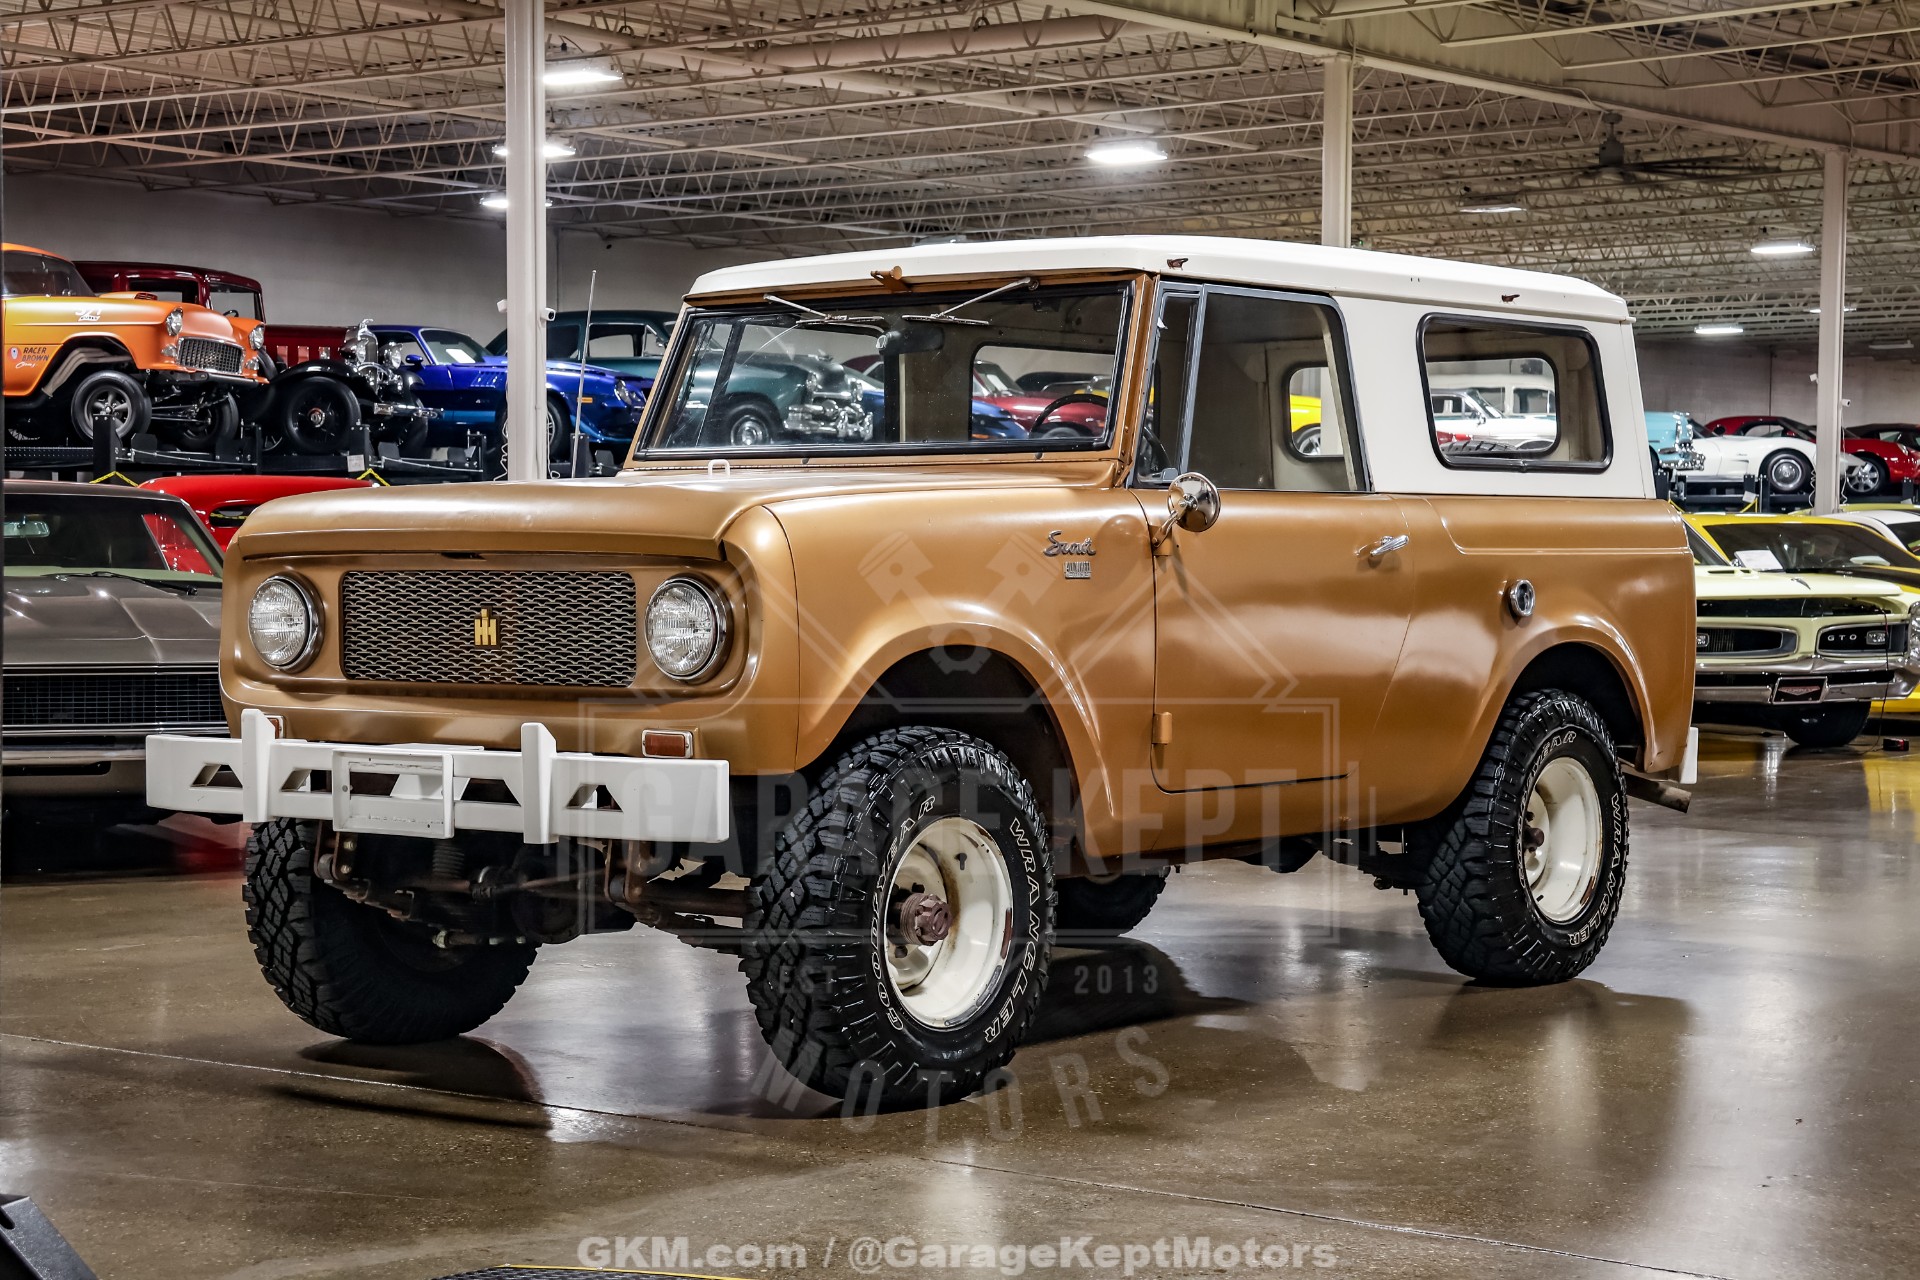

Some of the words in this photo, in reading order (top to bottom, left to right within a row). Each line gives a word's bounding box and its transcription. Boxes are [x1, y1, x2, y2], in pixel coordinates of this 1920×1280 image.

[22, 354, 50, 362] BROWN
[1827, 633, 1858, 643] GTO
[871, 795, 936, 1031] GOODYEAR
[984, 816, 1041, 1043] WRANGLER
[1568, 791, 1623, 947] WRANGLER
